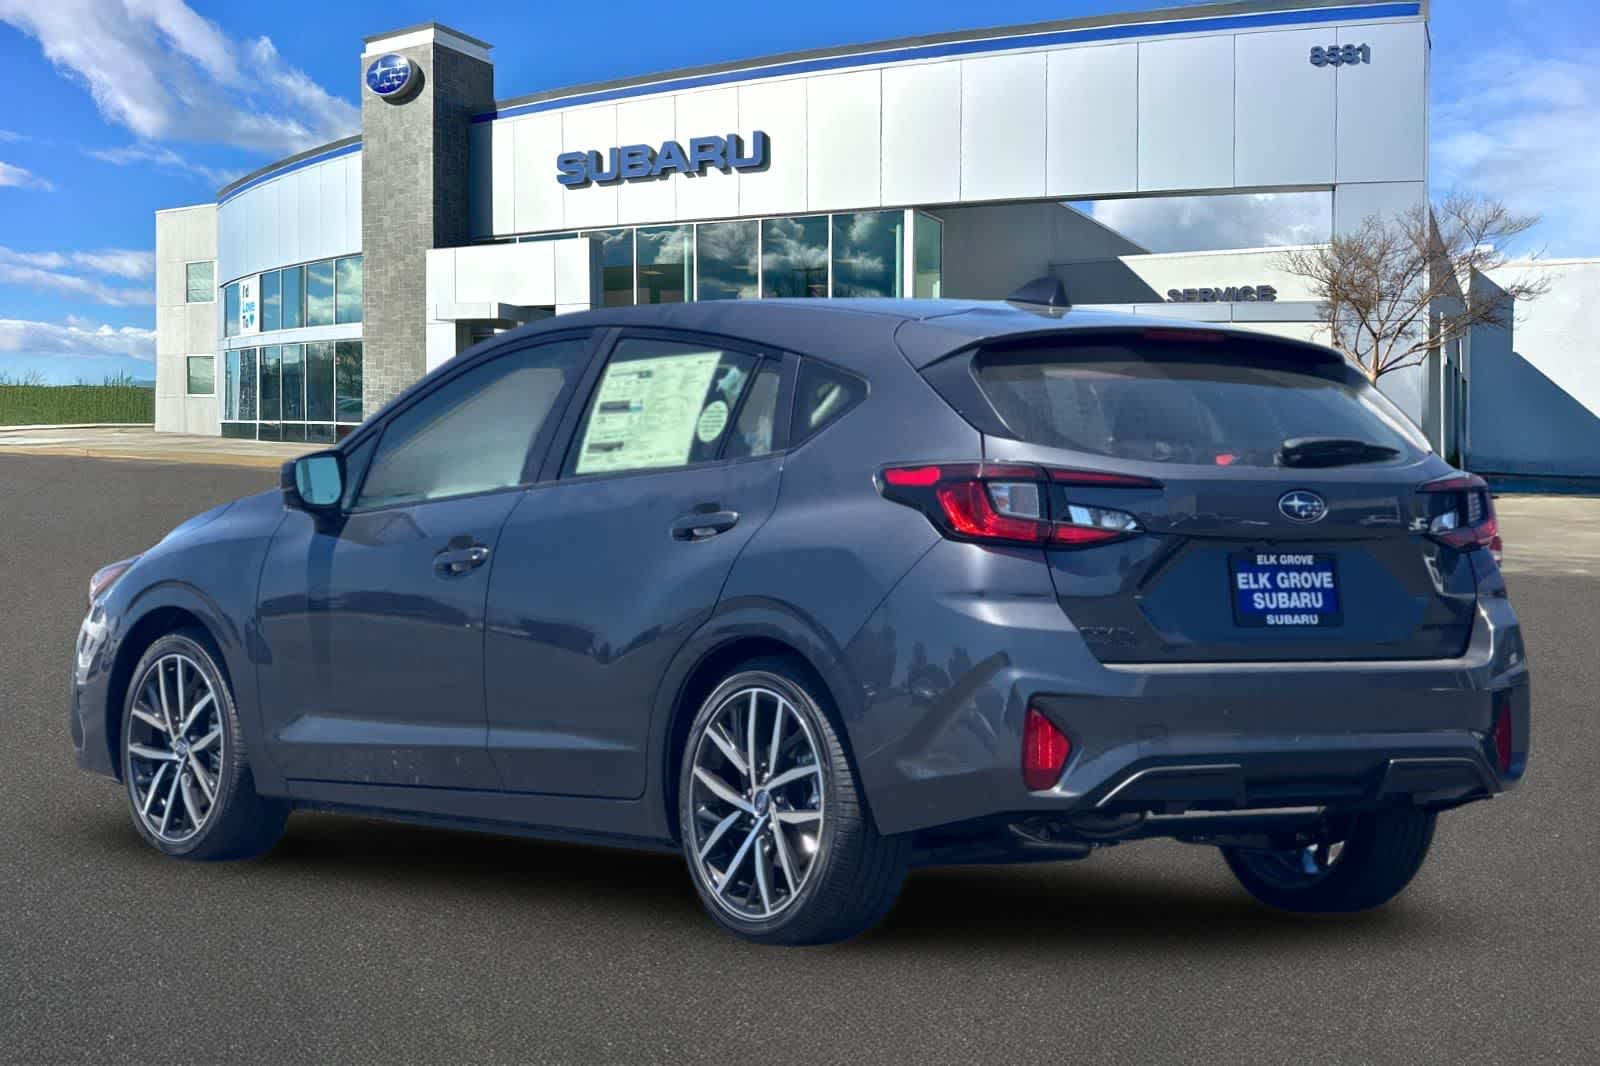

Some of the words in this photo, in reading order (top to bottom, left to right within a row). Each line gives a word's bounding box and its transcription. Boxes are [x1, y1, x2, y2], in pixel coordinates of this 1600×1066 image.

[556, 130, 771, 190] SUBARU
[1167, 285, 1277, 302] SERVICE
[1256, 554, 1277, 565] ELK
[1279, 554, 1314, 565] GROVE
[1236, 572, 1272, 589] ELK
[1276, 571, 1334, 589] GROVE
[1253, 591, 1324, 609] SUBARU
[1266, 614, 1319, 625] SUBARU
